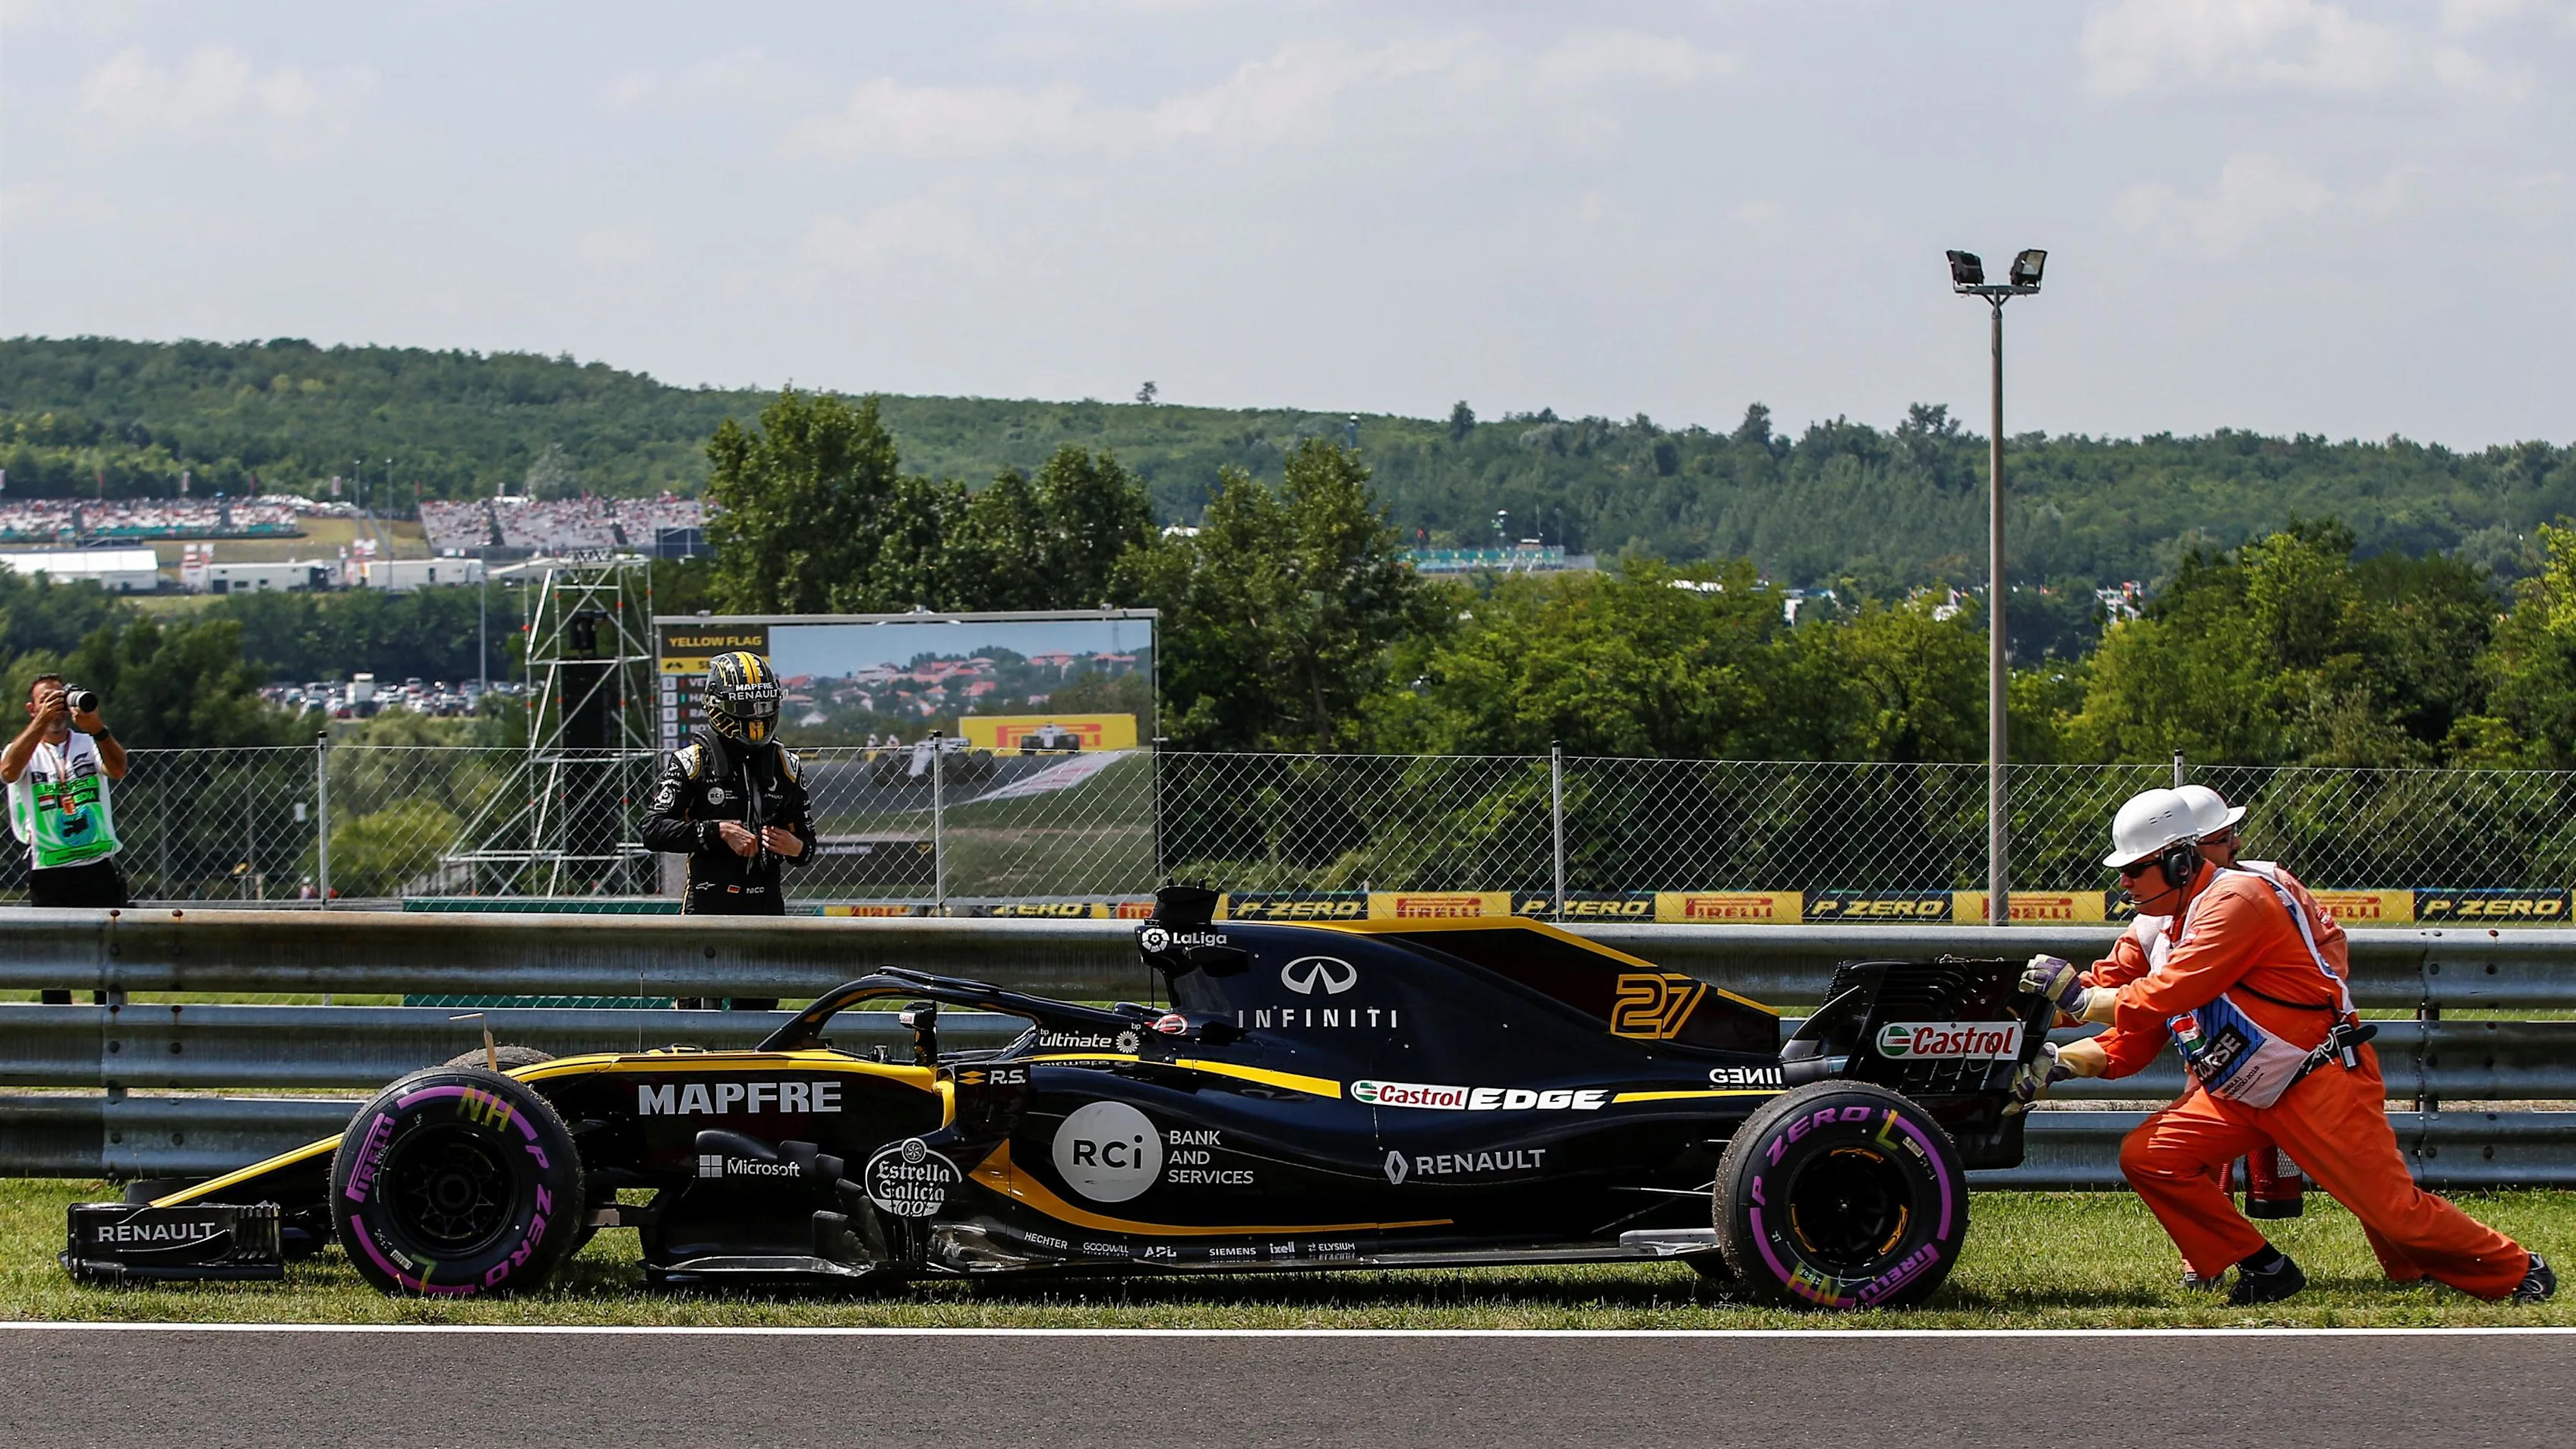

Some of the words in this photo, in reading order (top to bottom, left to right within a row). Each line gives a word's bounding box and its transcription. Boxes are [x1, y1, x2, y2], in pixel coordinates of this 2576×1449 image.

[669, 636, 724, 648] YELLOW
[727, 636, 762, 646] FLAG
[688, 677, 705, 687] VE
[736, 682, 773, 691] MAPFRE
[689, 693, 703, 702] HA
[729, 689, 778, 700] RENAULT
[689, 709, 709, 718] RA
[690, 724, 708, 733] BO
[996, 724, 1102, 749] PILI
[1236, 901, 1261, 917] P
[1267, 901, 1362, 917] ZERO
[1397, 897, 1482, 919] PIRELLI
[1520, 901, 1546, 915] P
[1551, 901, 1649, 916] ZERO
[1685, 898, 1773, 919] PIRELLI
[1810, 900, 1839, 914] P
[1844, 900, 1946, 915] ZERO
[1982, 898, 2072, 919] PRELLI
[2423, 899, 2451, 915] P
[2457, 899, 2563, 916] ZERO
[1173, 932, 1227, 946] LaLiga
[1610, 973, 1707, 1040] 27
[1131, 1022, 1141, 1031] bp
[1238, 1009, 1397, 1028] INFINITI
[1039, 1033, 1113, 1048] ultimate
[1040, 1028, 1050, 1037] bp
[1913, 1026, 2015, 1055] Castrol
[990, 1069, 1026, 1085] R.S.
[639, 1081, 841, 1116] MAPFRE
[1379, 1084, 1463, 1107] Castrol
[1467, 1087, 1610, 1111] EDGE
[456, 1084, 517, 1132] NH
[1170, 1130, 1220, 1145] BANK
[345, 1112, 396, 1203] PIRELLI
[525, 1144, 550, 1169] P
[1169, 1151, 1210, 1164] AND
[1416, 1149, 1546, 1176] RENAULT
[1751, 1175, 1766, 1206] P
[1766, 1106, 1872, 1167] ZERO
[727, 1160, 800, 1177] Microsoft
[876, 1160, 950, 1182] Estrella
[1168, 1170, 1254, 1184] SERVICES
[879, 1179, 945, 1201] Galicia
[97, 1223, 216, 1242] RENAULT
[485, 1183, 552, 1287] ZERO
[1024, 1232, 1068, 1249] HECHTER
[1083, 1242, 1129, 1253] GOODWILL
[1209, 1247, 1256, 1256] SIEMENS
[1270, 1241, 1296, 1254] ixell
[1318, 1242, 1356, 1252] ELYSIUM
[1859, 1242, 1940, 1306] PIRELLI
